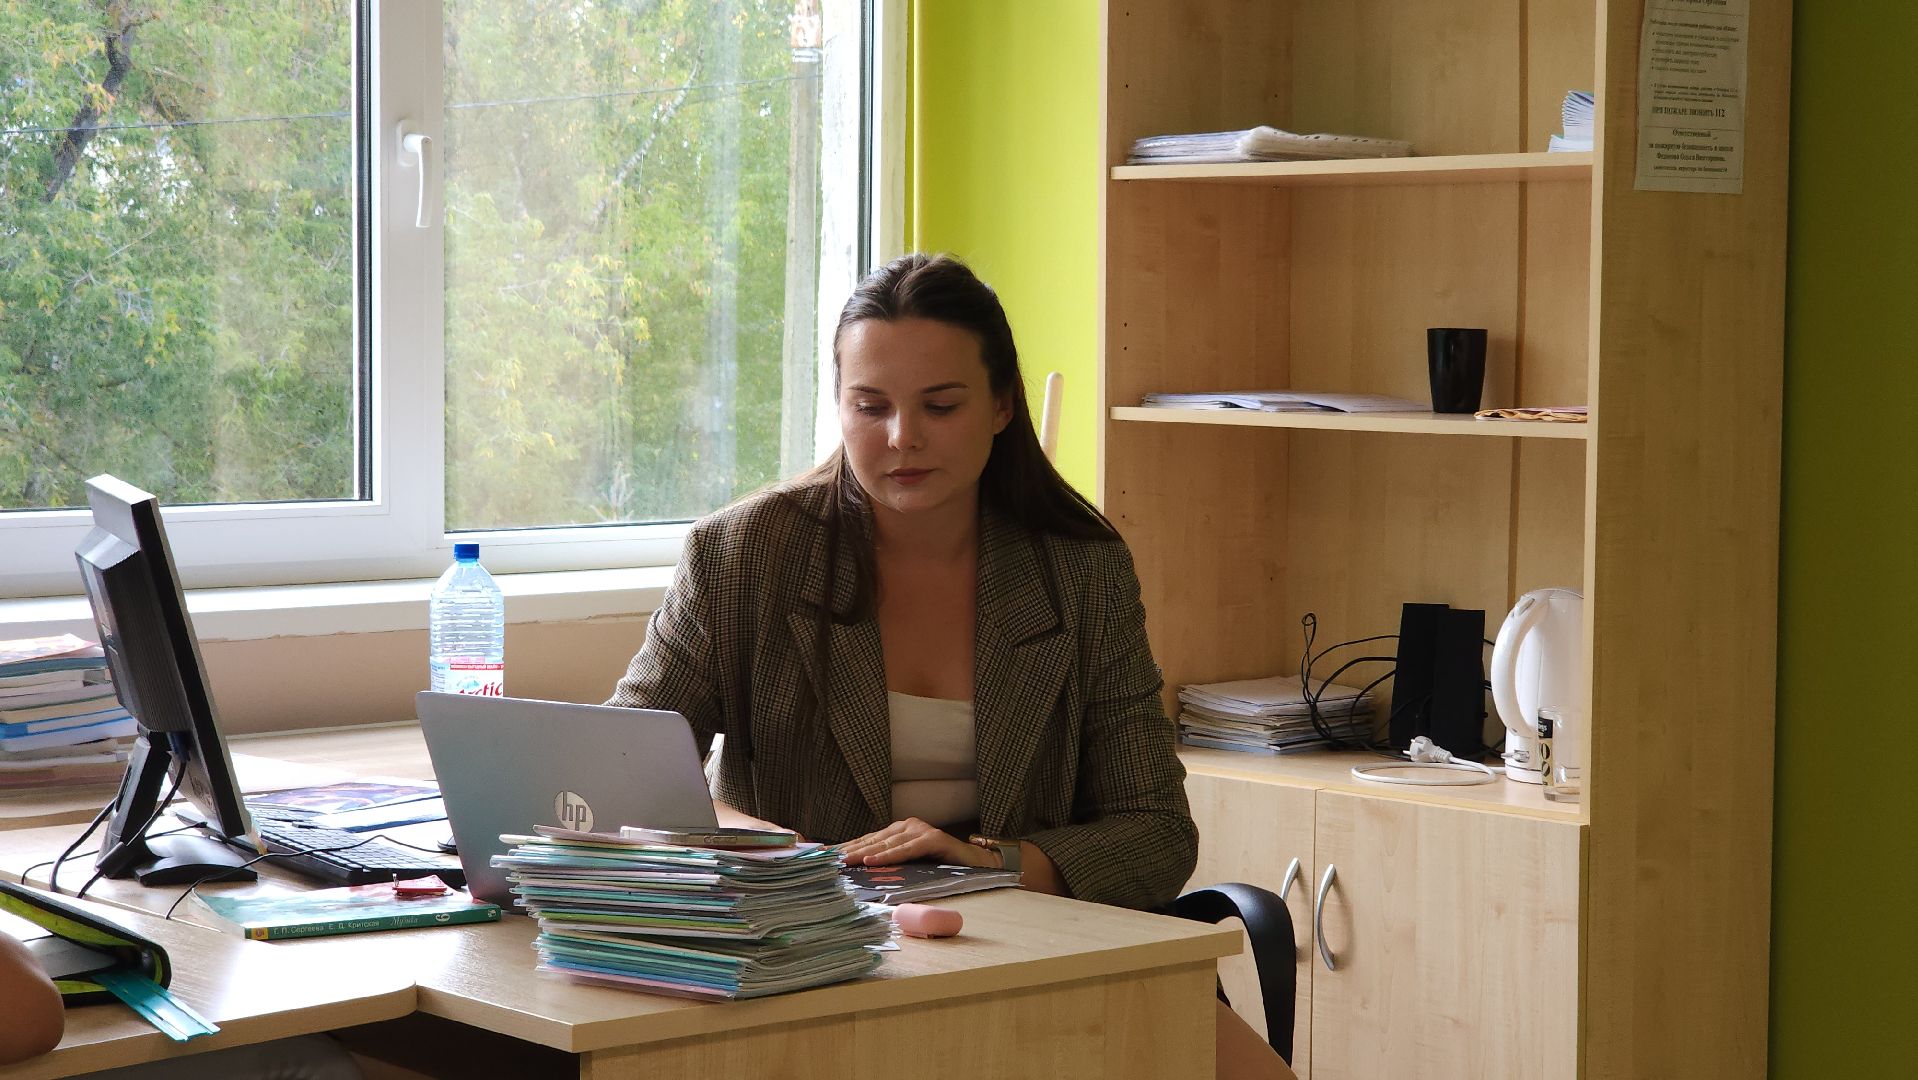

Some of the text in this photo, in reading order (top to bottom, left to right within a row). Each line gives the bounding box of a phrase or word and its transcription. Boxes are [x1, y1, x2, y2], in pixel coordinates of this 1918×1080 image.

[1664, 107, 1687, 115] ПОЖАРЕ
[1715, 108, 1725, 117] 112
[561, 790, 586, 831] hp
